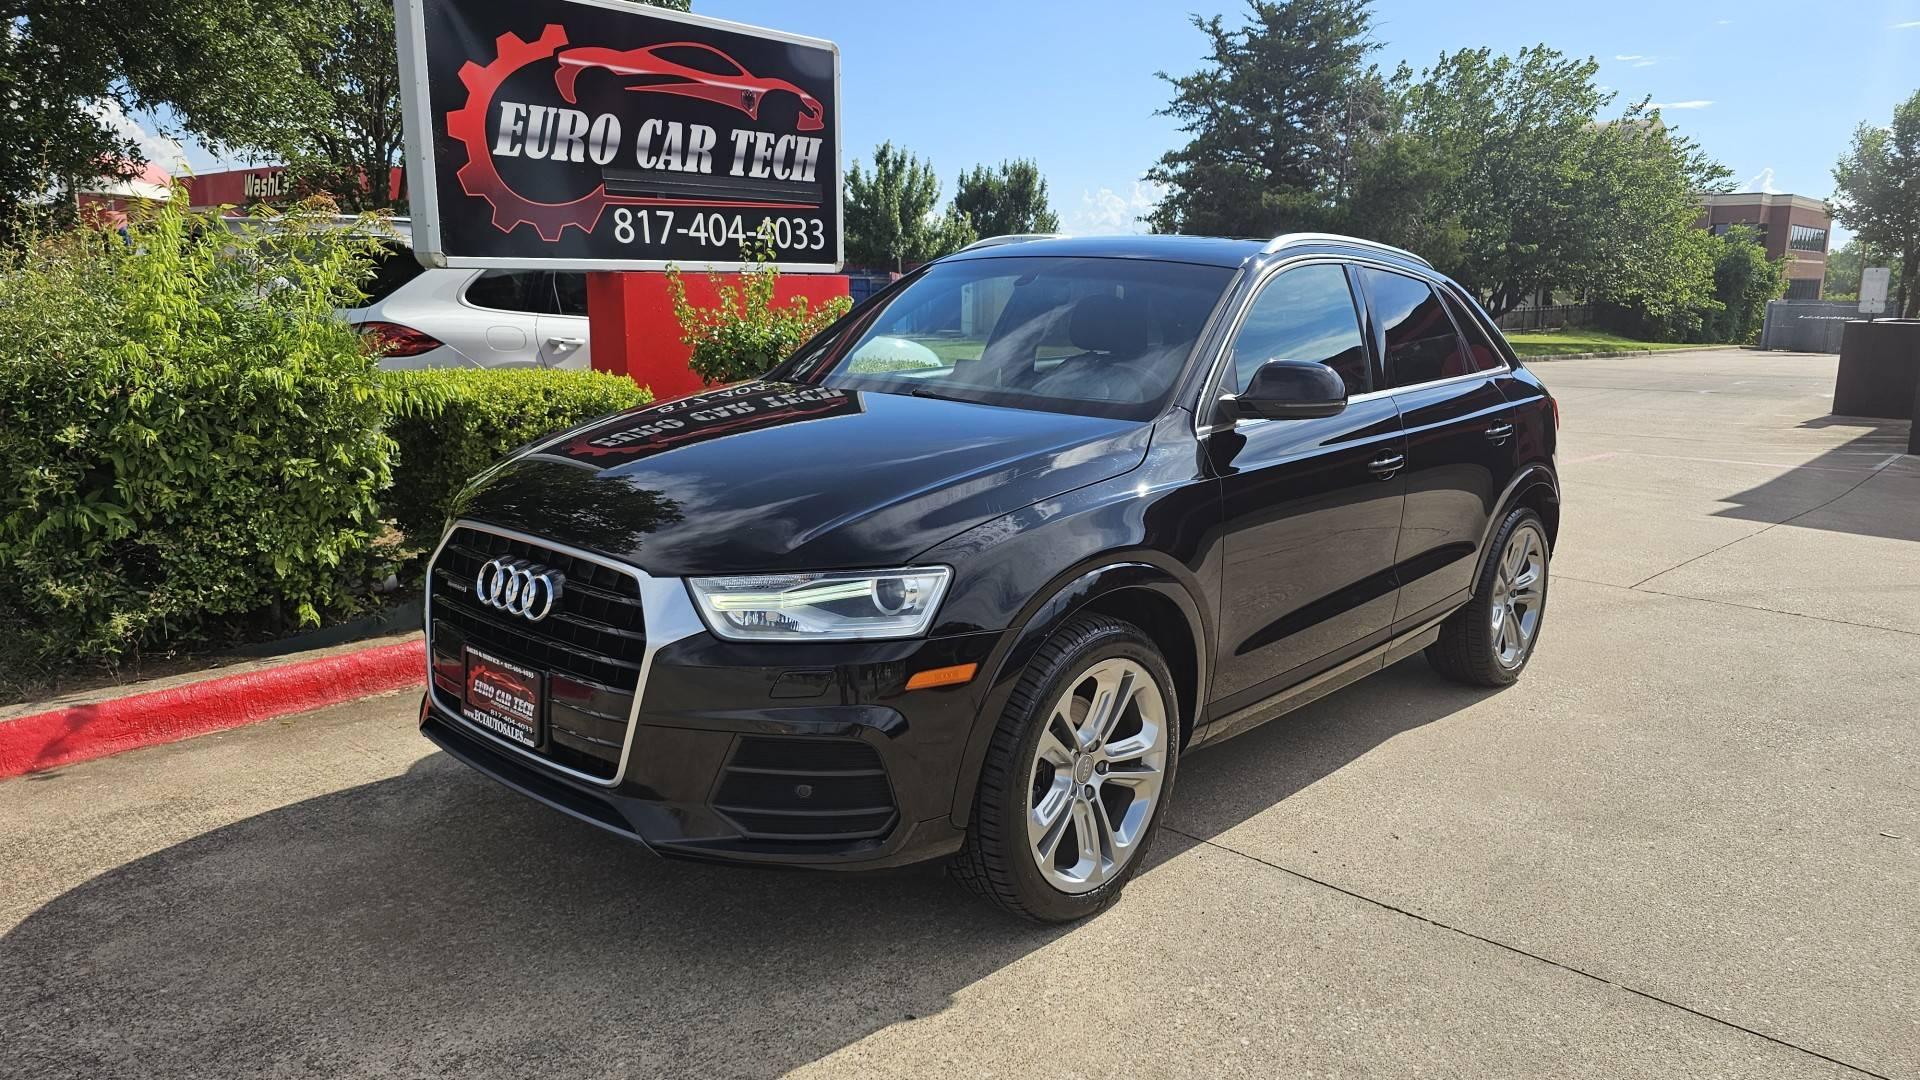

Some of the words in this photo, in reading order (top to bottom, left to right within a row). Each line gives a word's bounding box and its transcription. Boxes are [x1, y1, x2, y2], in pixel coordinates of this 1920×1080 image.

[493, 101, 622, 165] EURO
[636, 118, 717, 174] CAR
[730, 128, 823, 182] TECH
[614, 207, 826, 251] 817-404-4033
[473, 679, 495, 699] EURO
[495, 689, 512, 707] CAR
[513, 696, 535, 717] TECH
